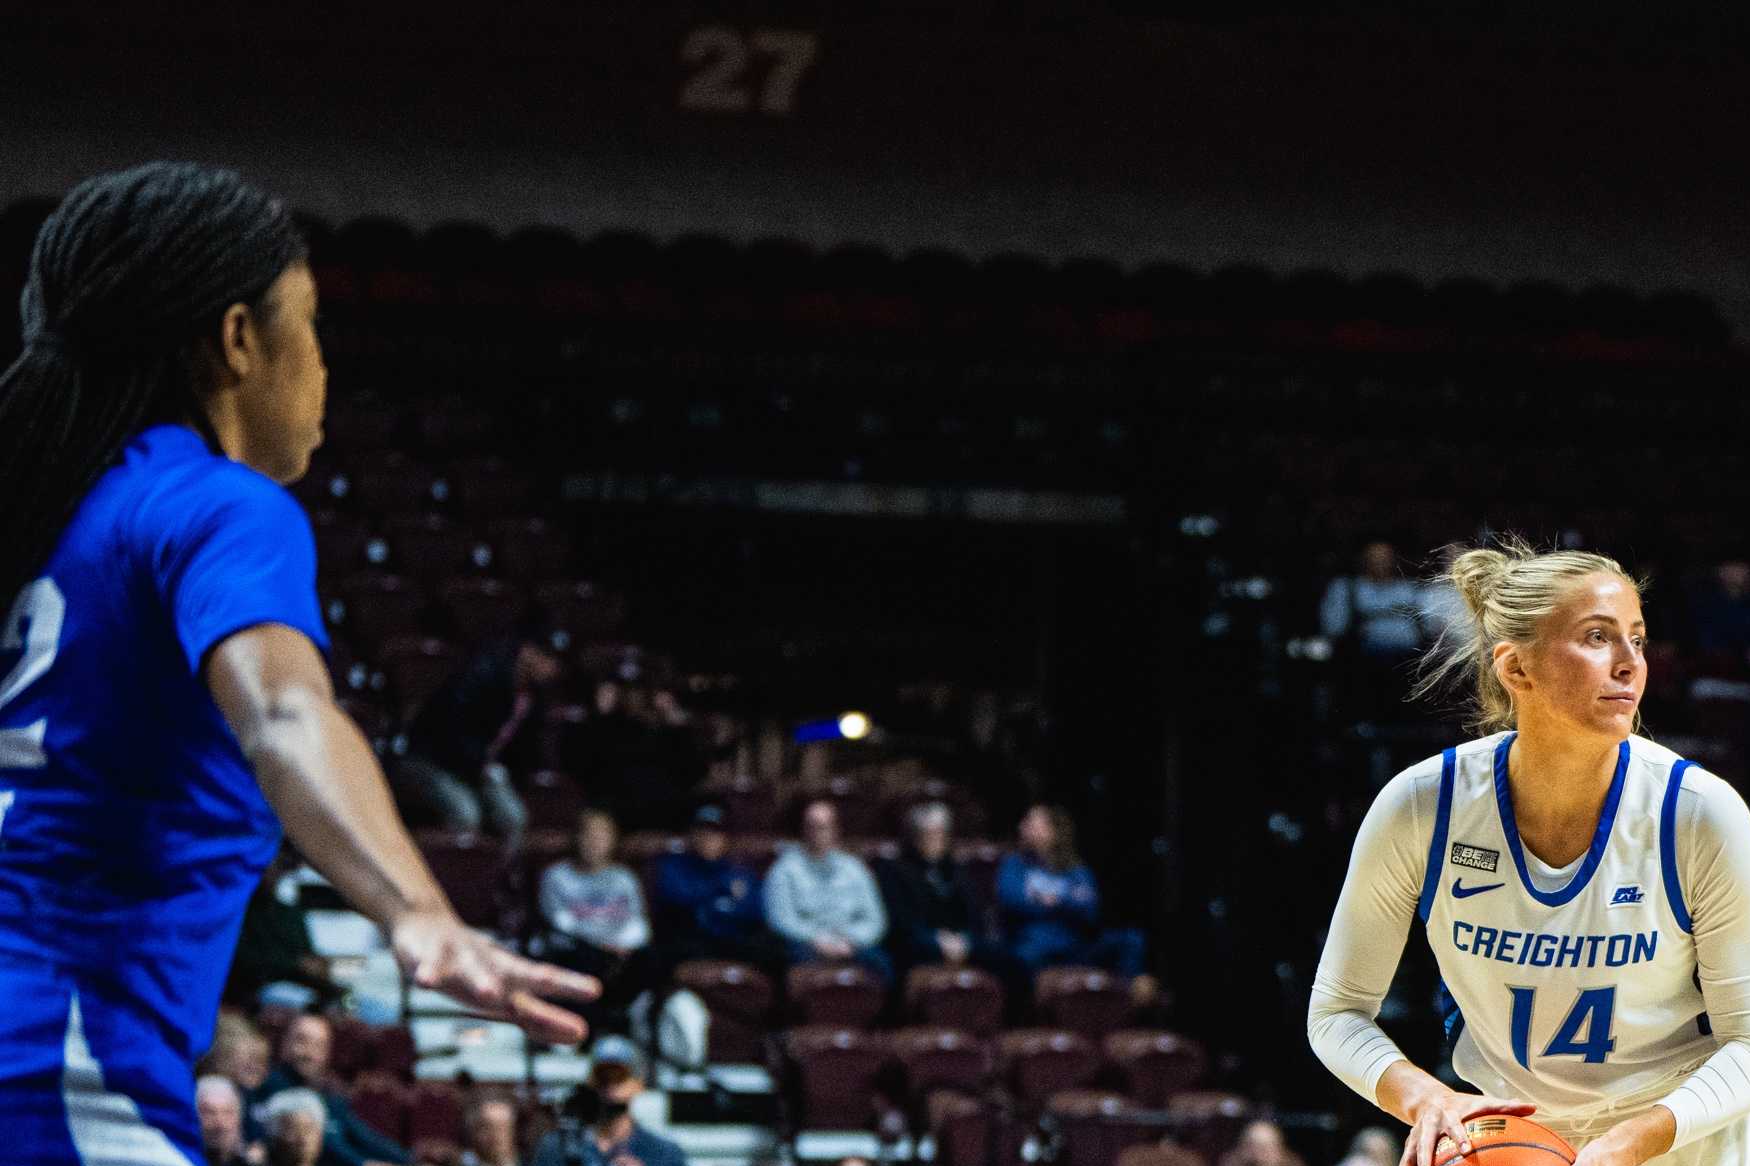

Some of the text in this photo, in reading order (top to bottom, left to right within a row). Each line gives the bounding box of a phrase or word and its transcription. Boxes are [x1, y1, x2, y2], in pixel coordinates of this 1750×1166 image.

[679, 27, 819, 113] 27
[1452, 855, 1496, 870] CHANGE
[1453, 920, 1658, 968] CREIGHTON
[1504, 983, 1618, 1072] 14
